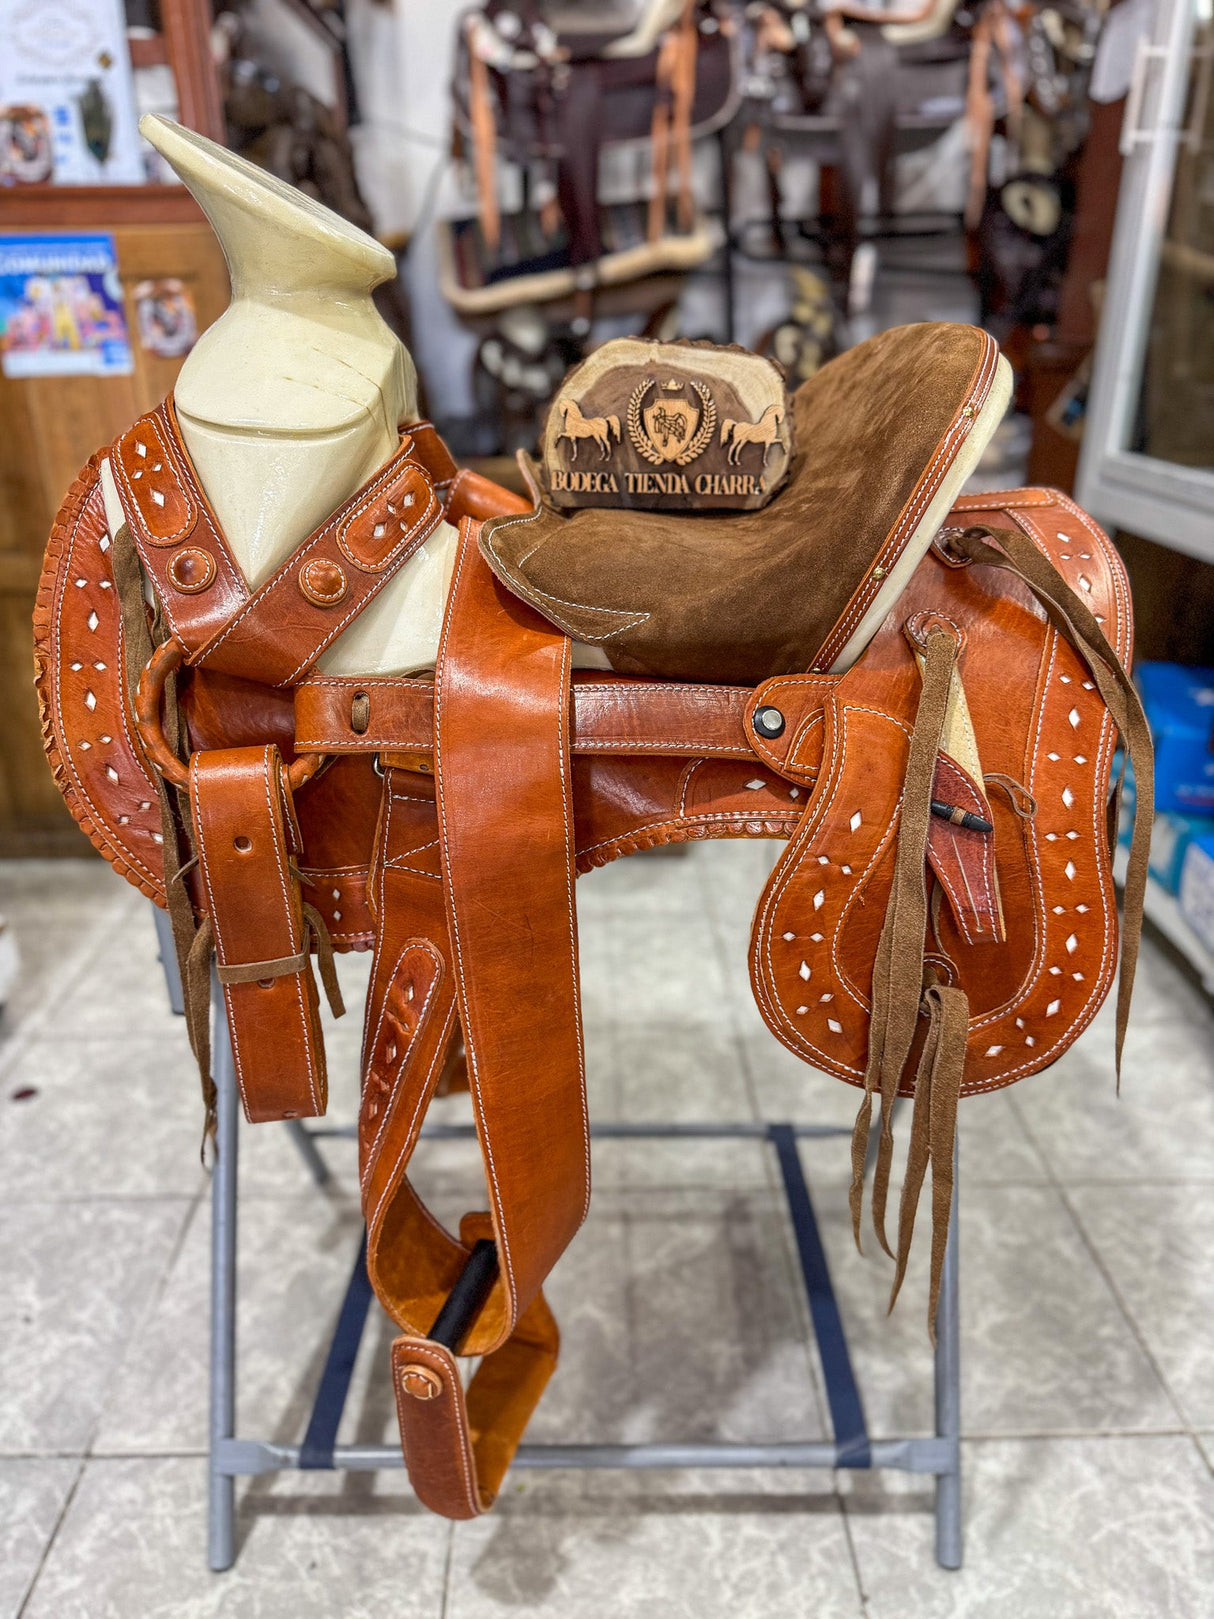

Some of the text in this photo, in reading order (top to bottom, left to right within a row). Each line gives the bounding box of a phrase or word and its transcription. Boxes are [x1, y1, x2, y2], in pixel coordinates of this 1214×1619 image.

[551, 471, 766, 496] BODEGA TIENDA CHARRA
